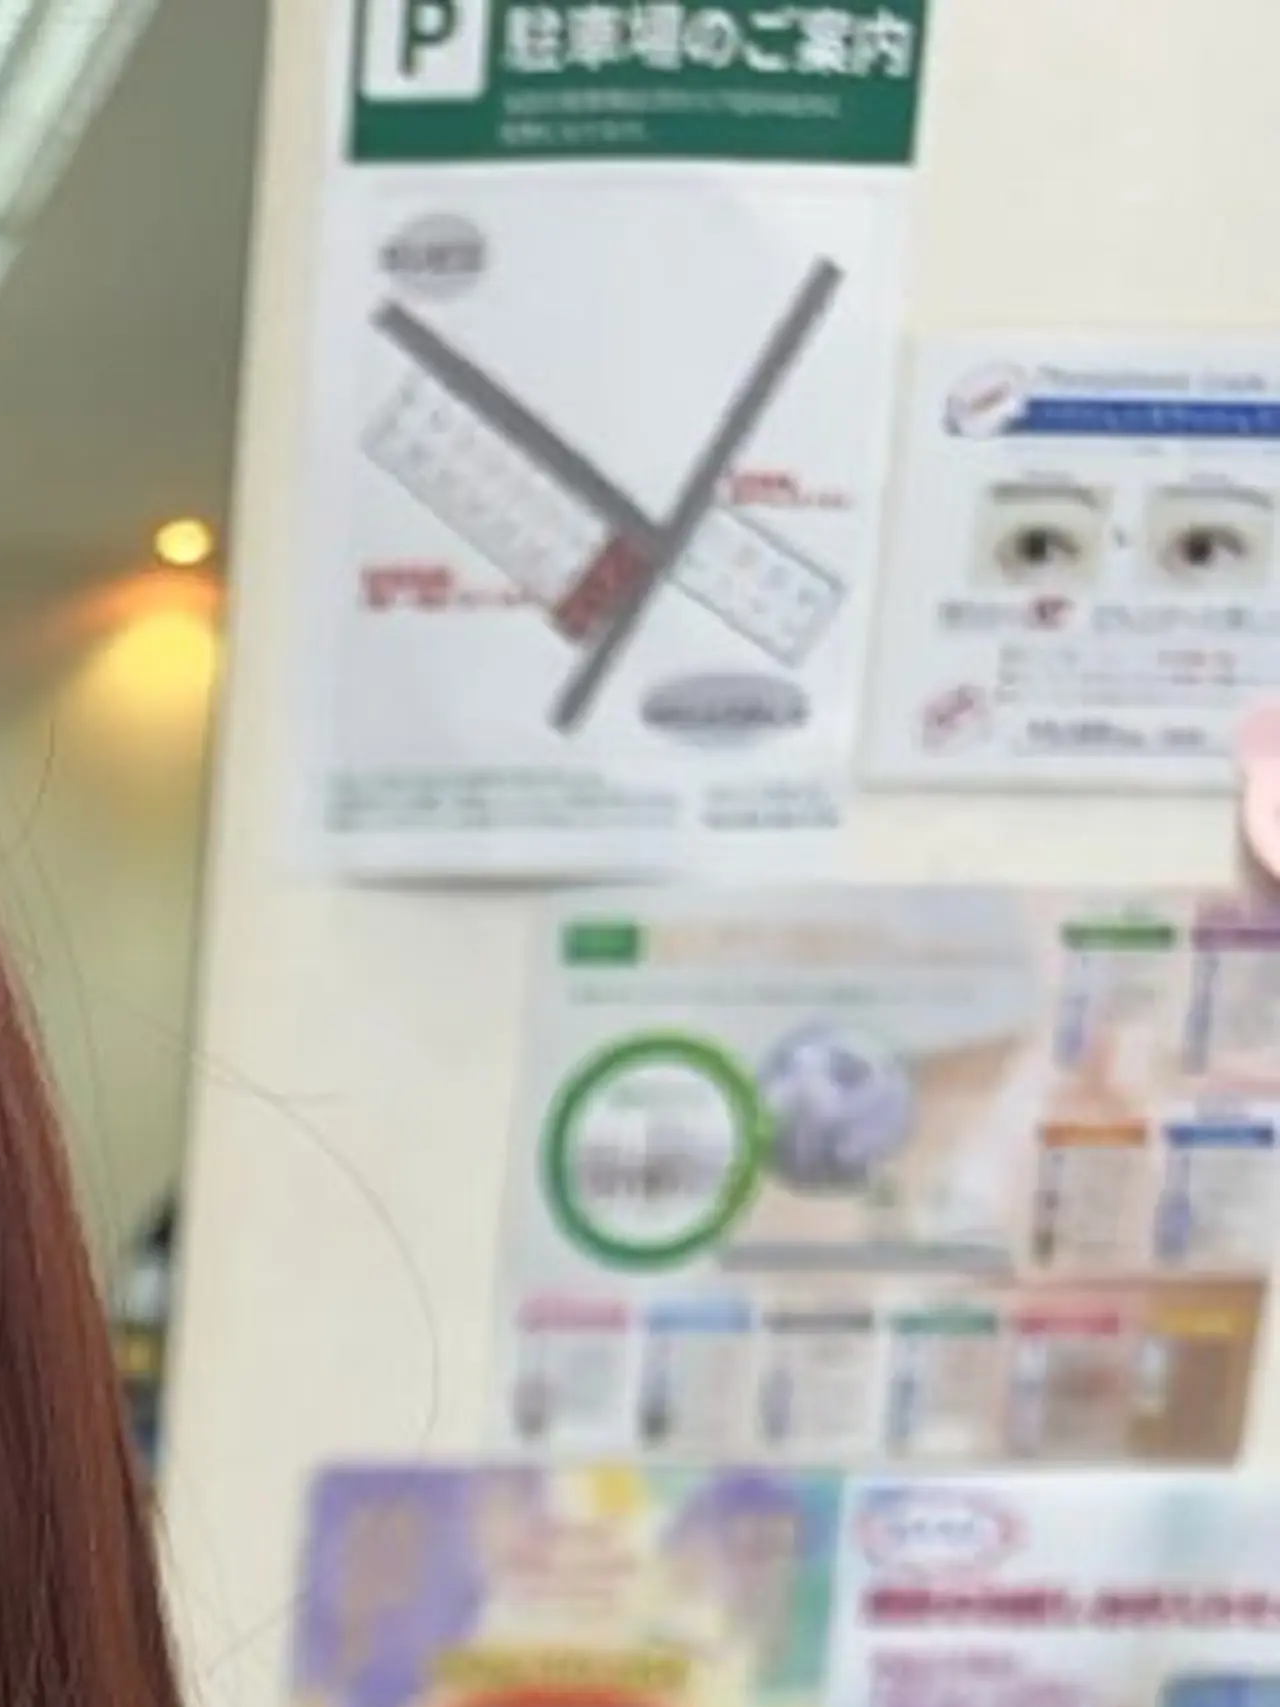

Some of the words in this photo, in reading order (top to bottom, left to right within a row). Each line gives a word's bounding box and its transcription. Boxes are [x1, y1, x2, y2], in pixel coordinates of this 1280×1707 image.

[397, 0, 458, 77] P
[502, 3, 915, 76] 駐車場のご案内
